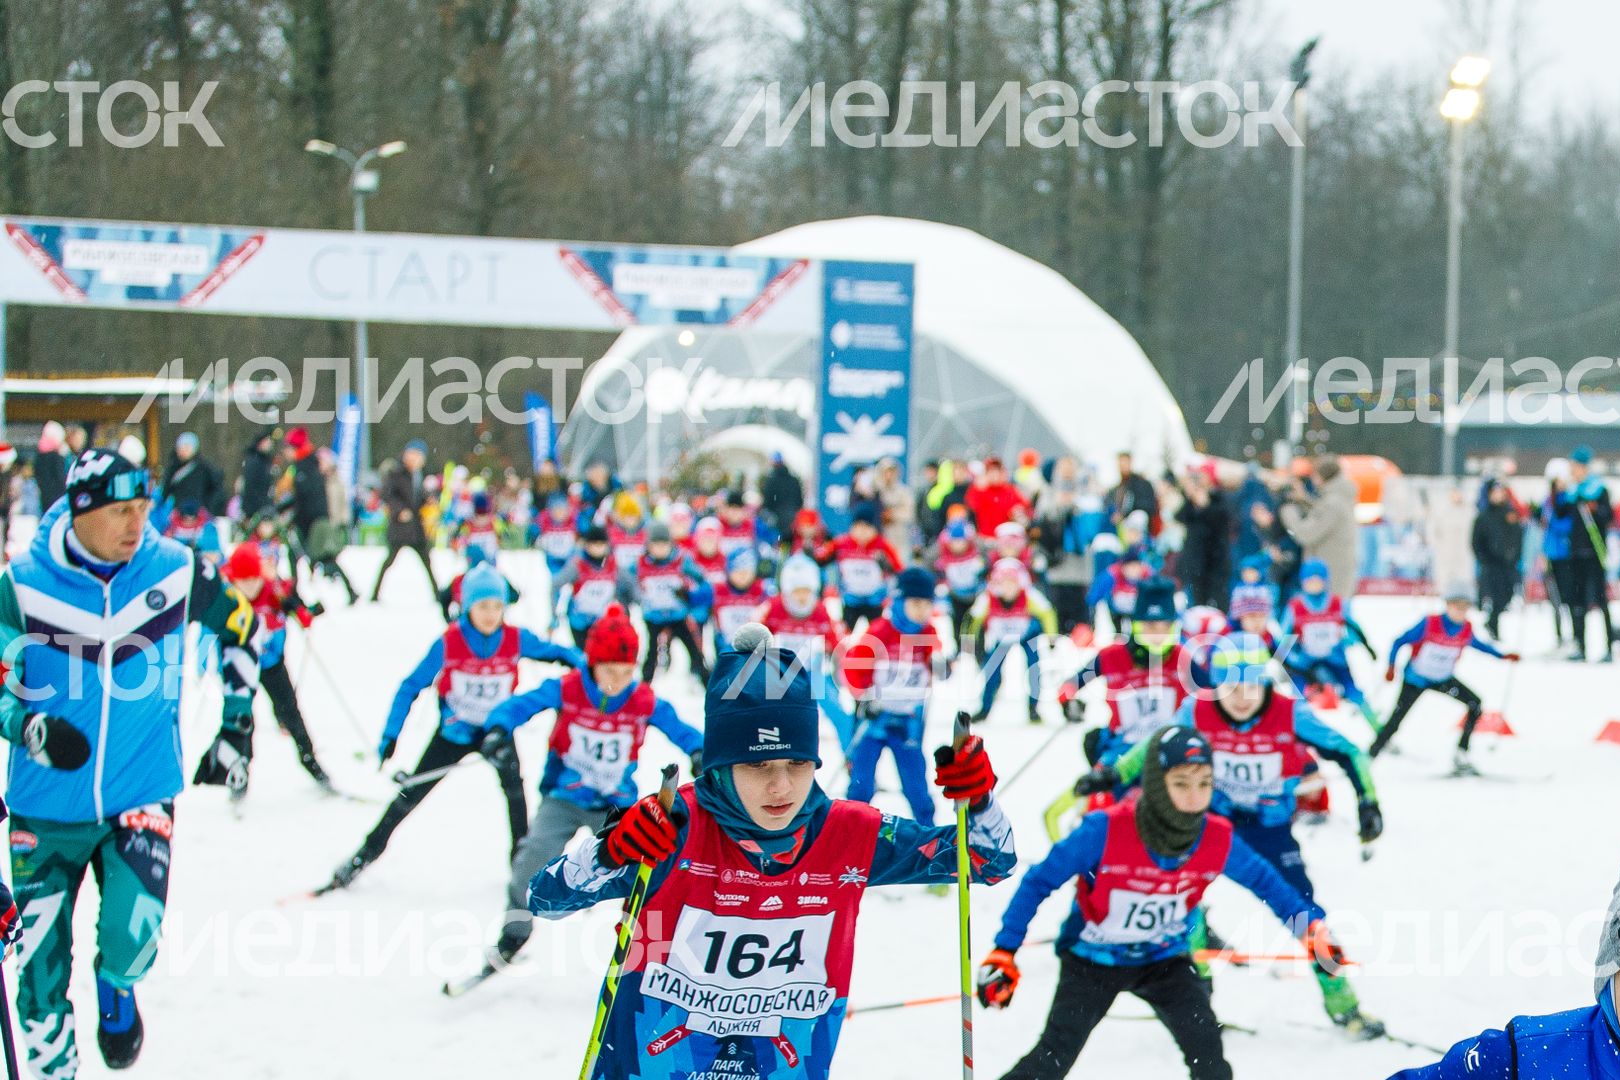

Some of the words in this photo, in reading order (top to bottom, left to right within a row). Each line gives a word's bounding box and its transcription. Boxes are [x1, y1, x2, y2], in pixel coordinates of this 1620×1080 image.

[309, 244, 504, 304] СТАРТ
[748, 743, 791, 752] NORDSKI
[797, 895, 829, 905] ЗИМА
[703, 929, 805, 980] 164
[648, 969, 829, 1014] МАНЖОСОВСКАЯ
[707, 1019, 761, 1036] ЛЫЖНЯ
[711, 1059, 744, 1072] ПАРК
